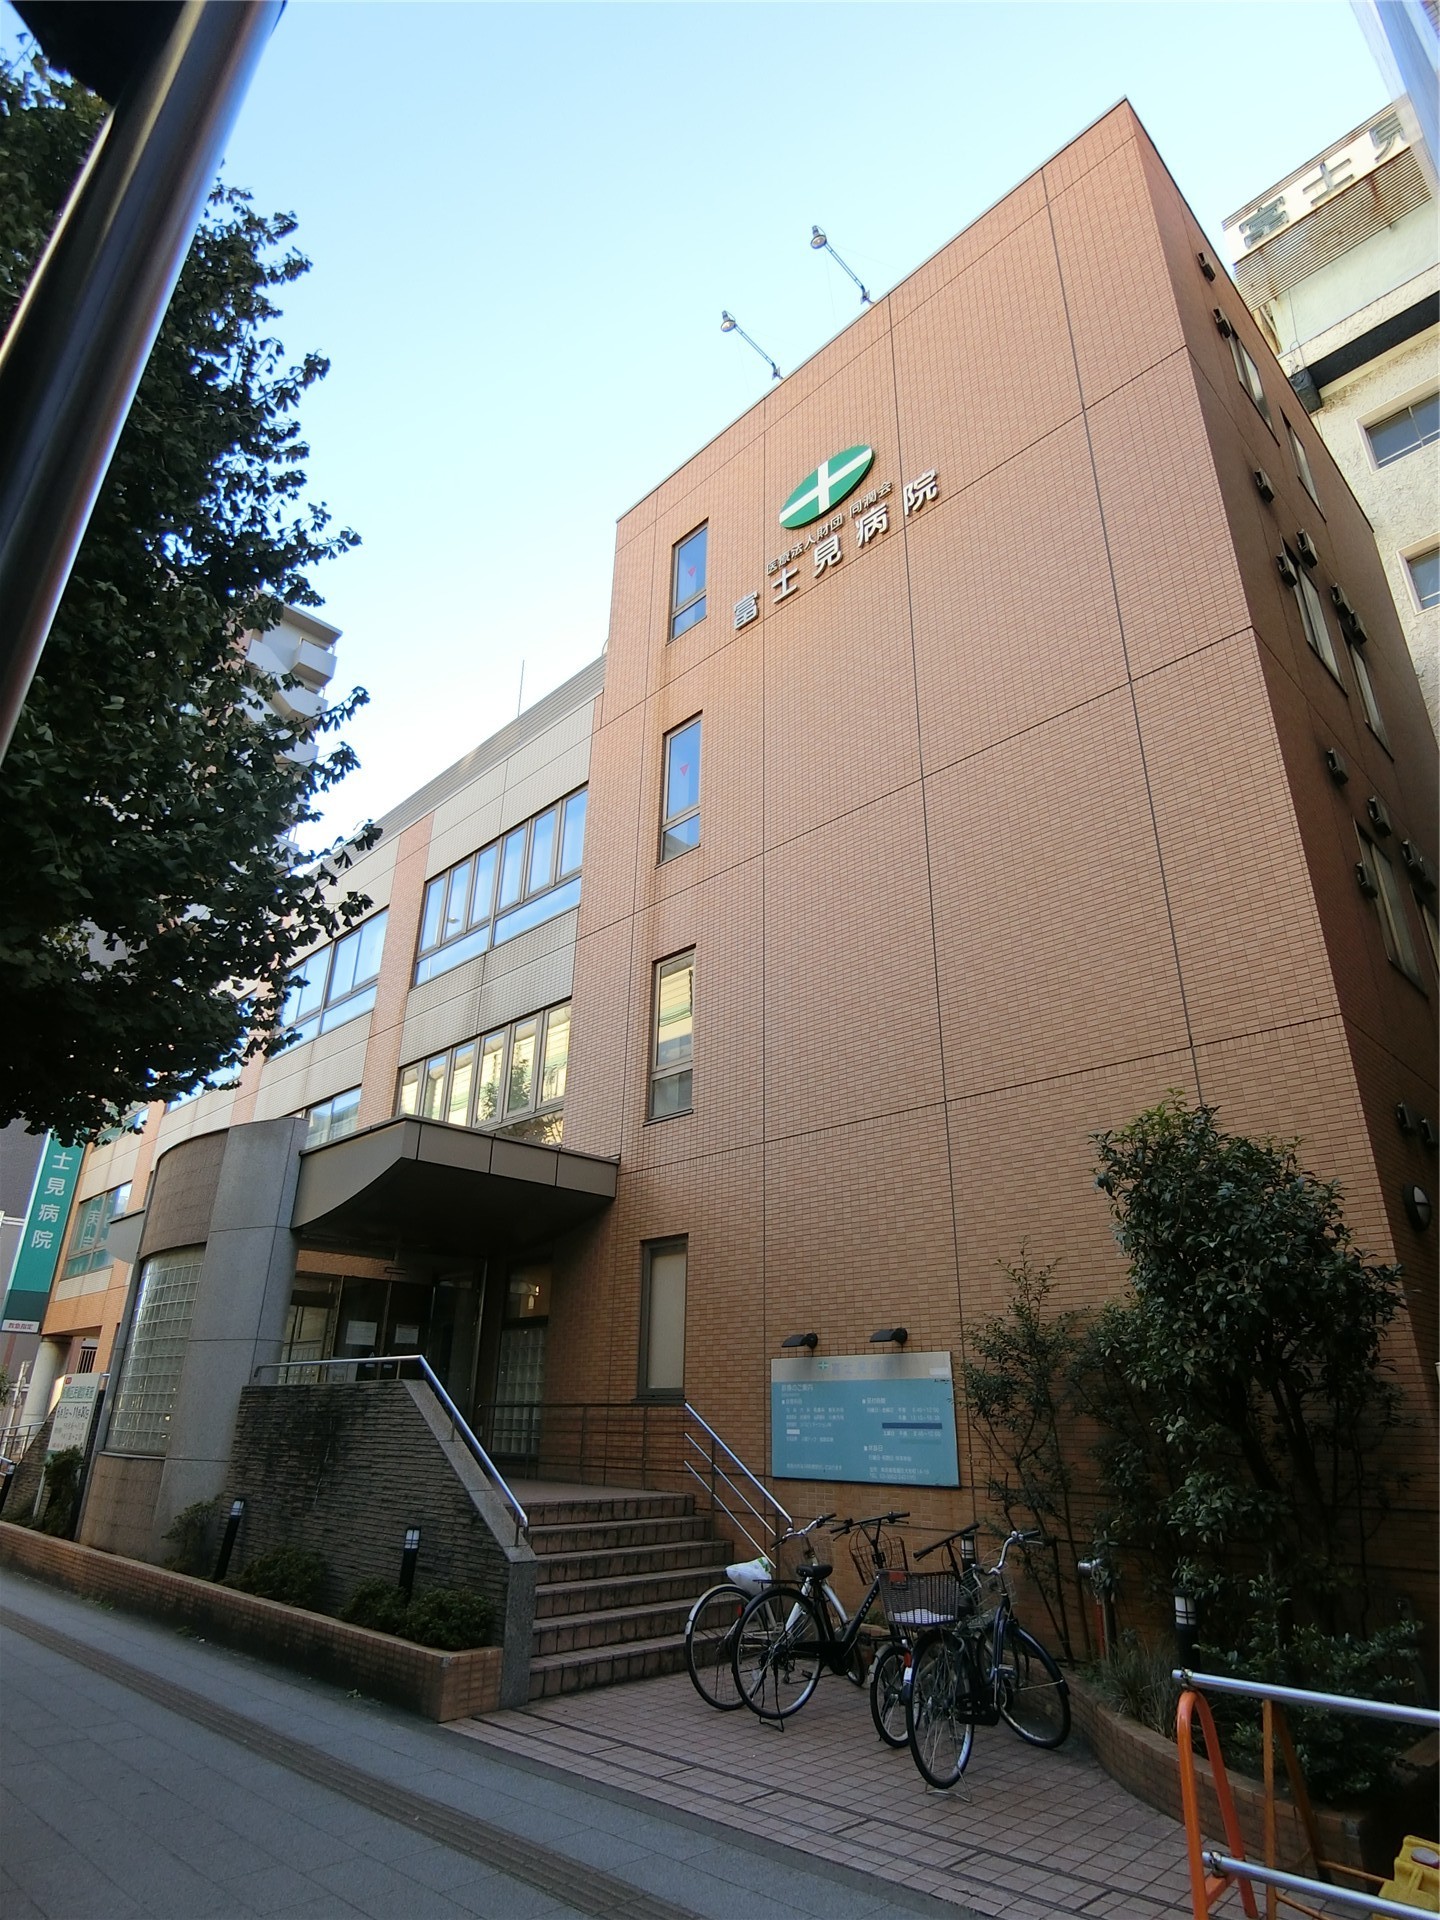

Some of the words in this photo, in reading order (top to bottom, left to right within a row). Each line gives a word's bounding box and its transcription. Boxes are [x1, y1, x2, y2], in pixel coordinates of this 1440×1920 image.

[733, 469, 939, 630] 富士見病院
[31, 1140, 76, 1249] 士見病院
